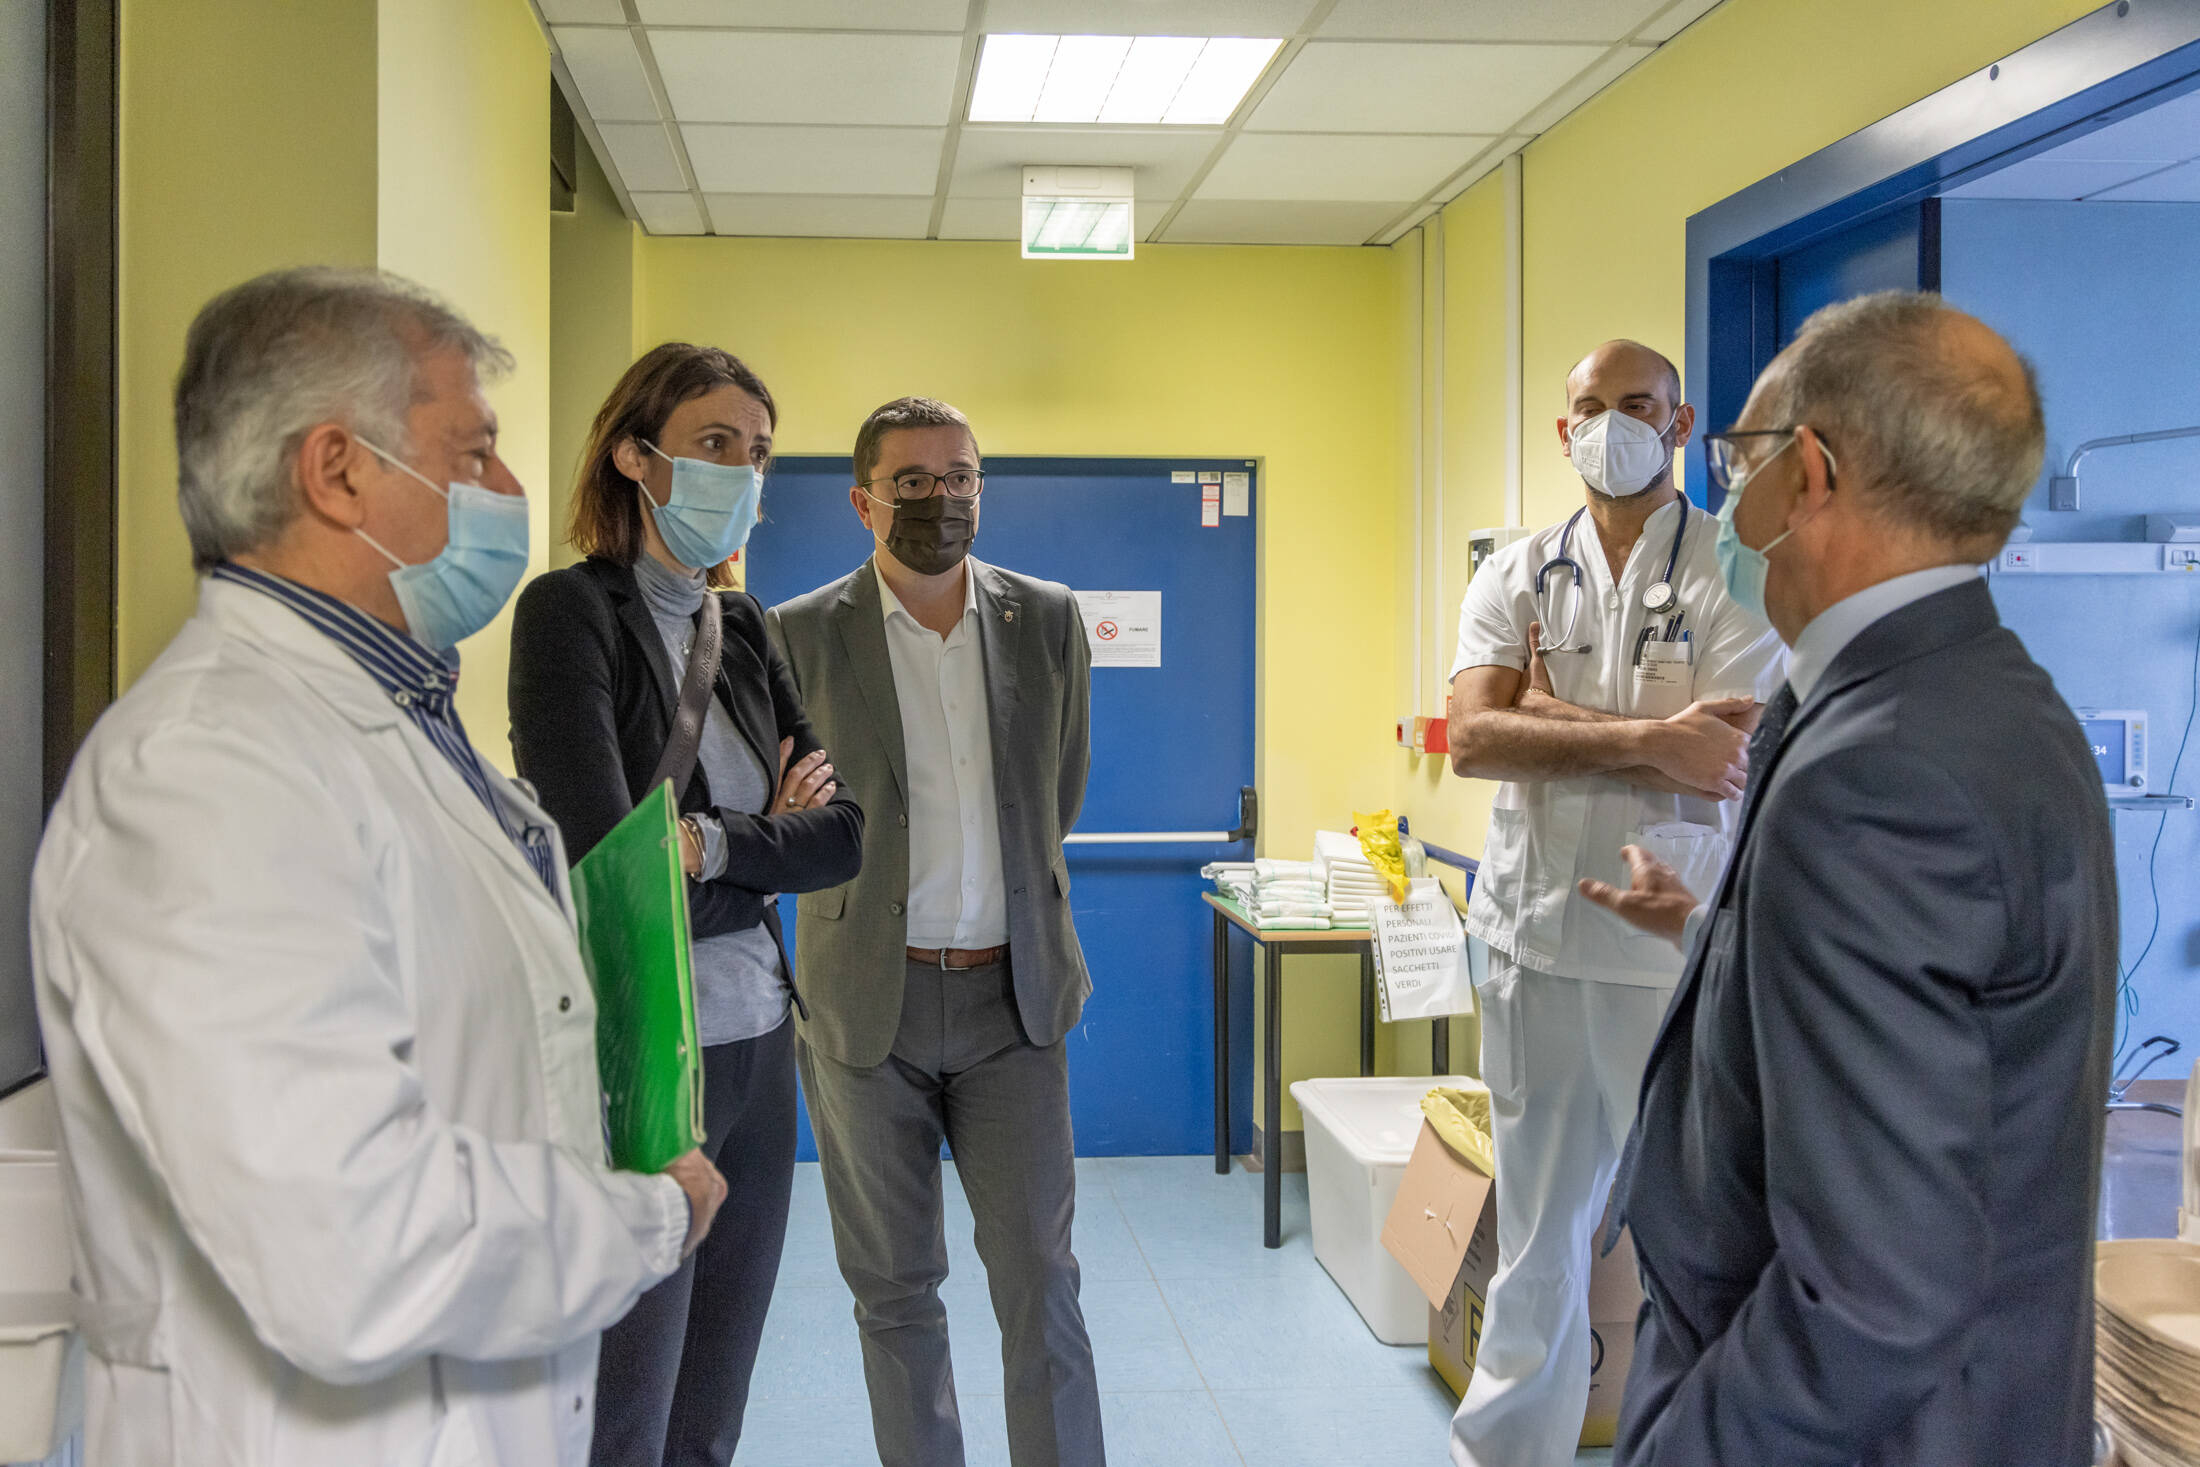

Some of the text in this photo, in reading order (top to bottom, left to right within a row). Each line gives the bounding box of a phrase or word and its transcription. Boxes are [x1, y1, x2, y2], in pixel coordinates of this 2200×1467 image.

[1384, 903, 1432, 913] PER EFFETTI
[1386, 919, 1432, 928] PERSONALI
[1388, 933, 1427, 943] PAZIENTI
[1390, 945, 1457, 958] POSITIVI USARE
[1392, 962, 1440, 974] SACCHETTI
[1394, 979, 1422, 989] VERDI
